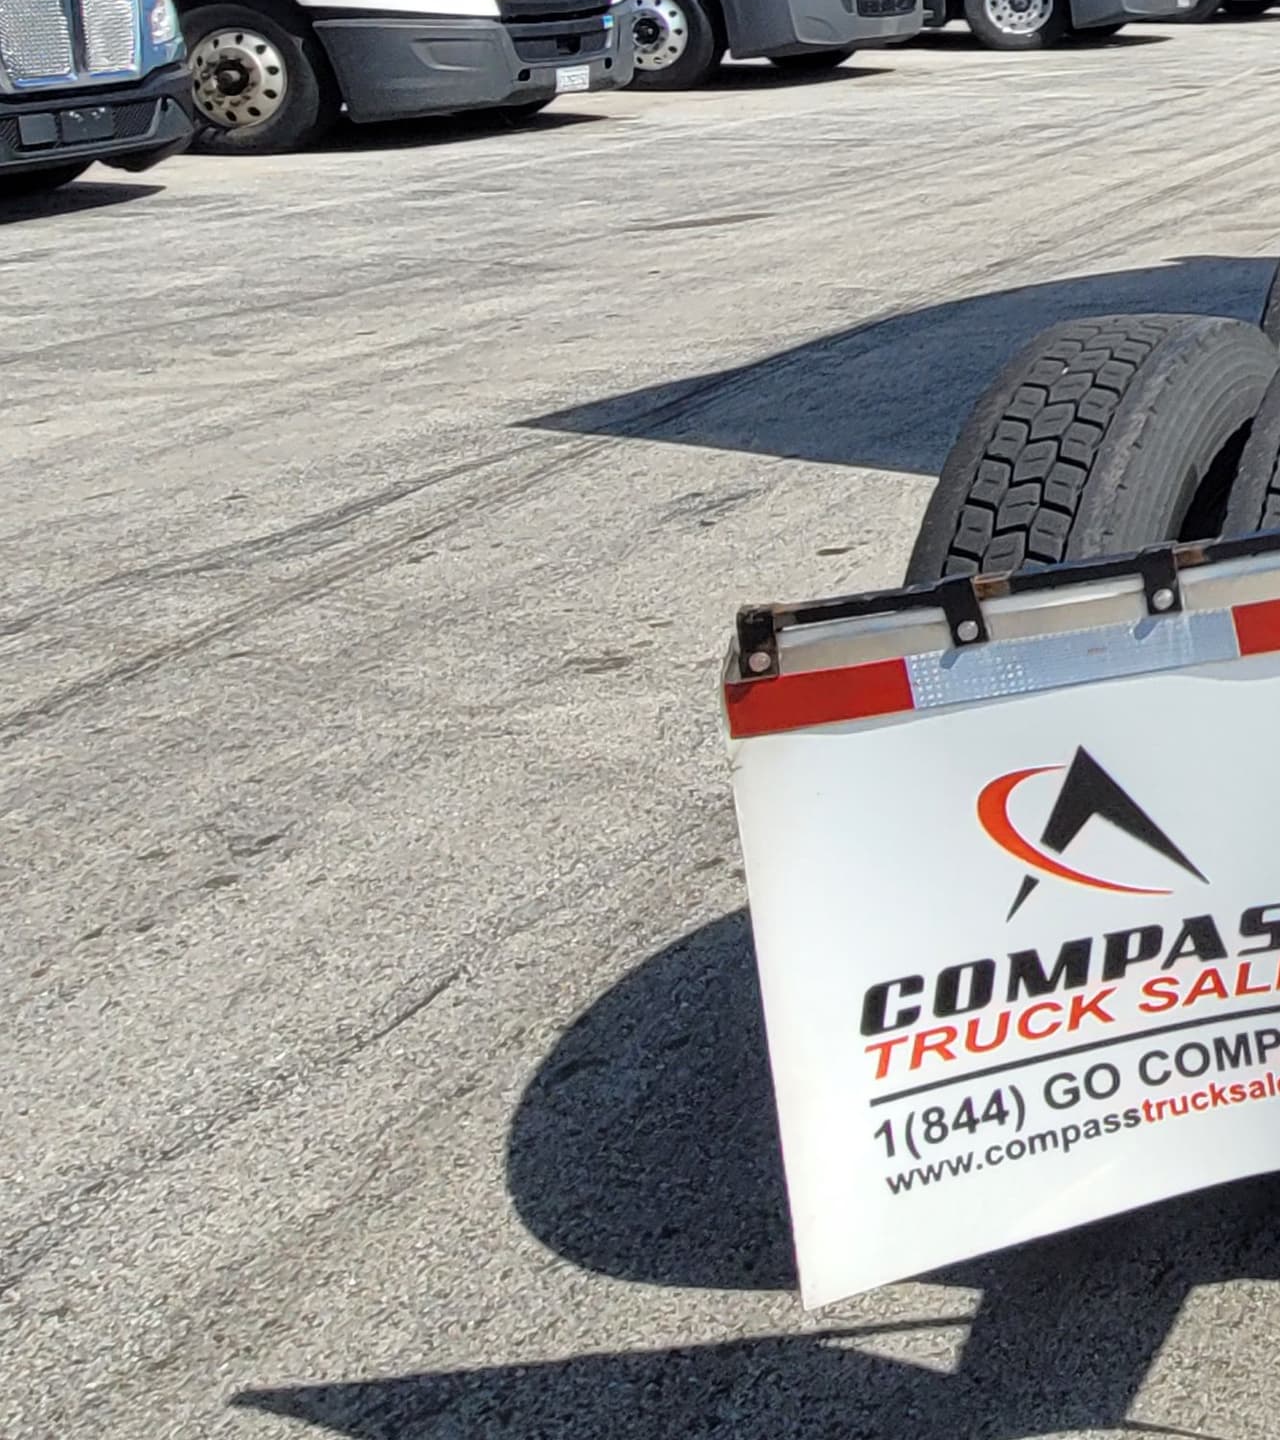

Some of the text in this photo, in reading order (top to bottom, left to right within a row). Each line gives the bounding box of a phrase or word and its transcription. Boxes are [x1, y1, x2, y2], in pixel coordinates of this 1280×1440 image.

[865, 987, 1117, 1079] TRUCK
[873, 1084, 1027, 1160] 1(844)
[1043, 1062, 1121, 1111] GO
